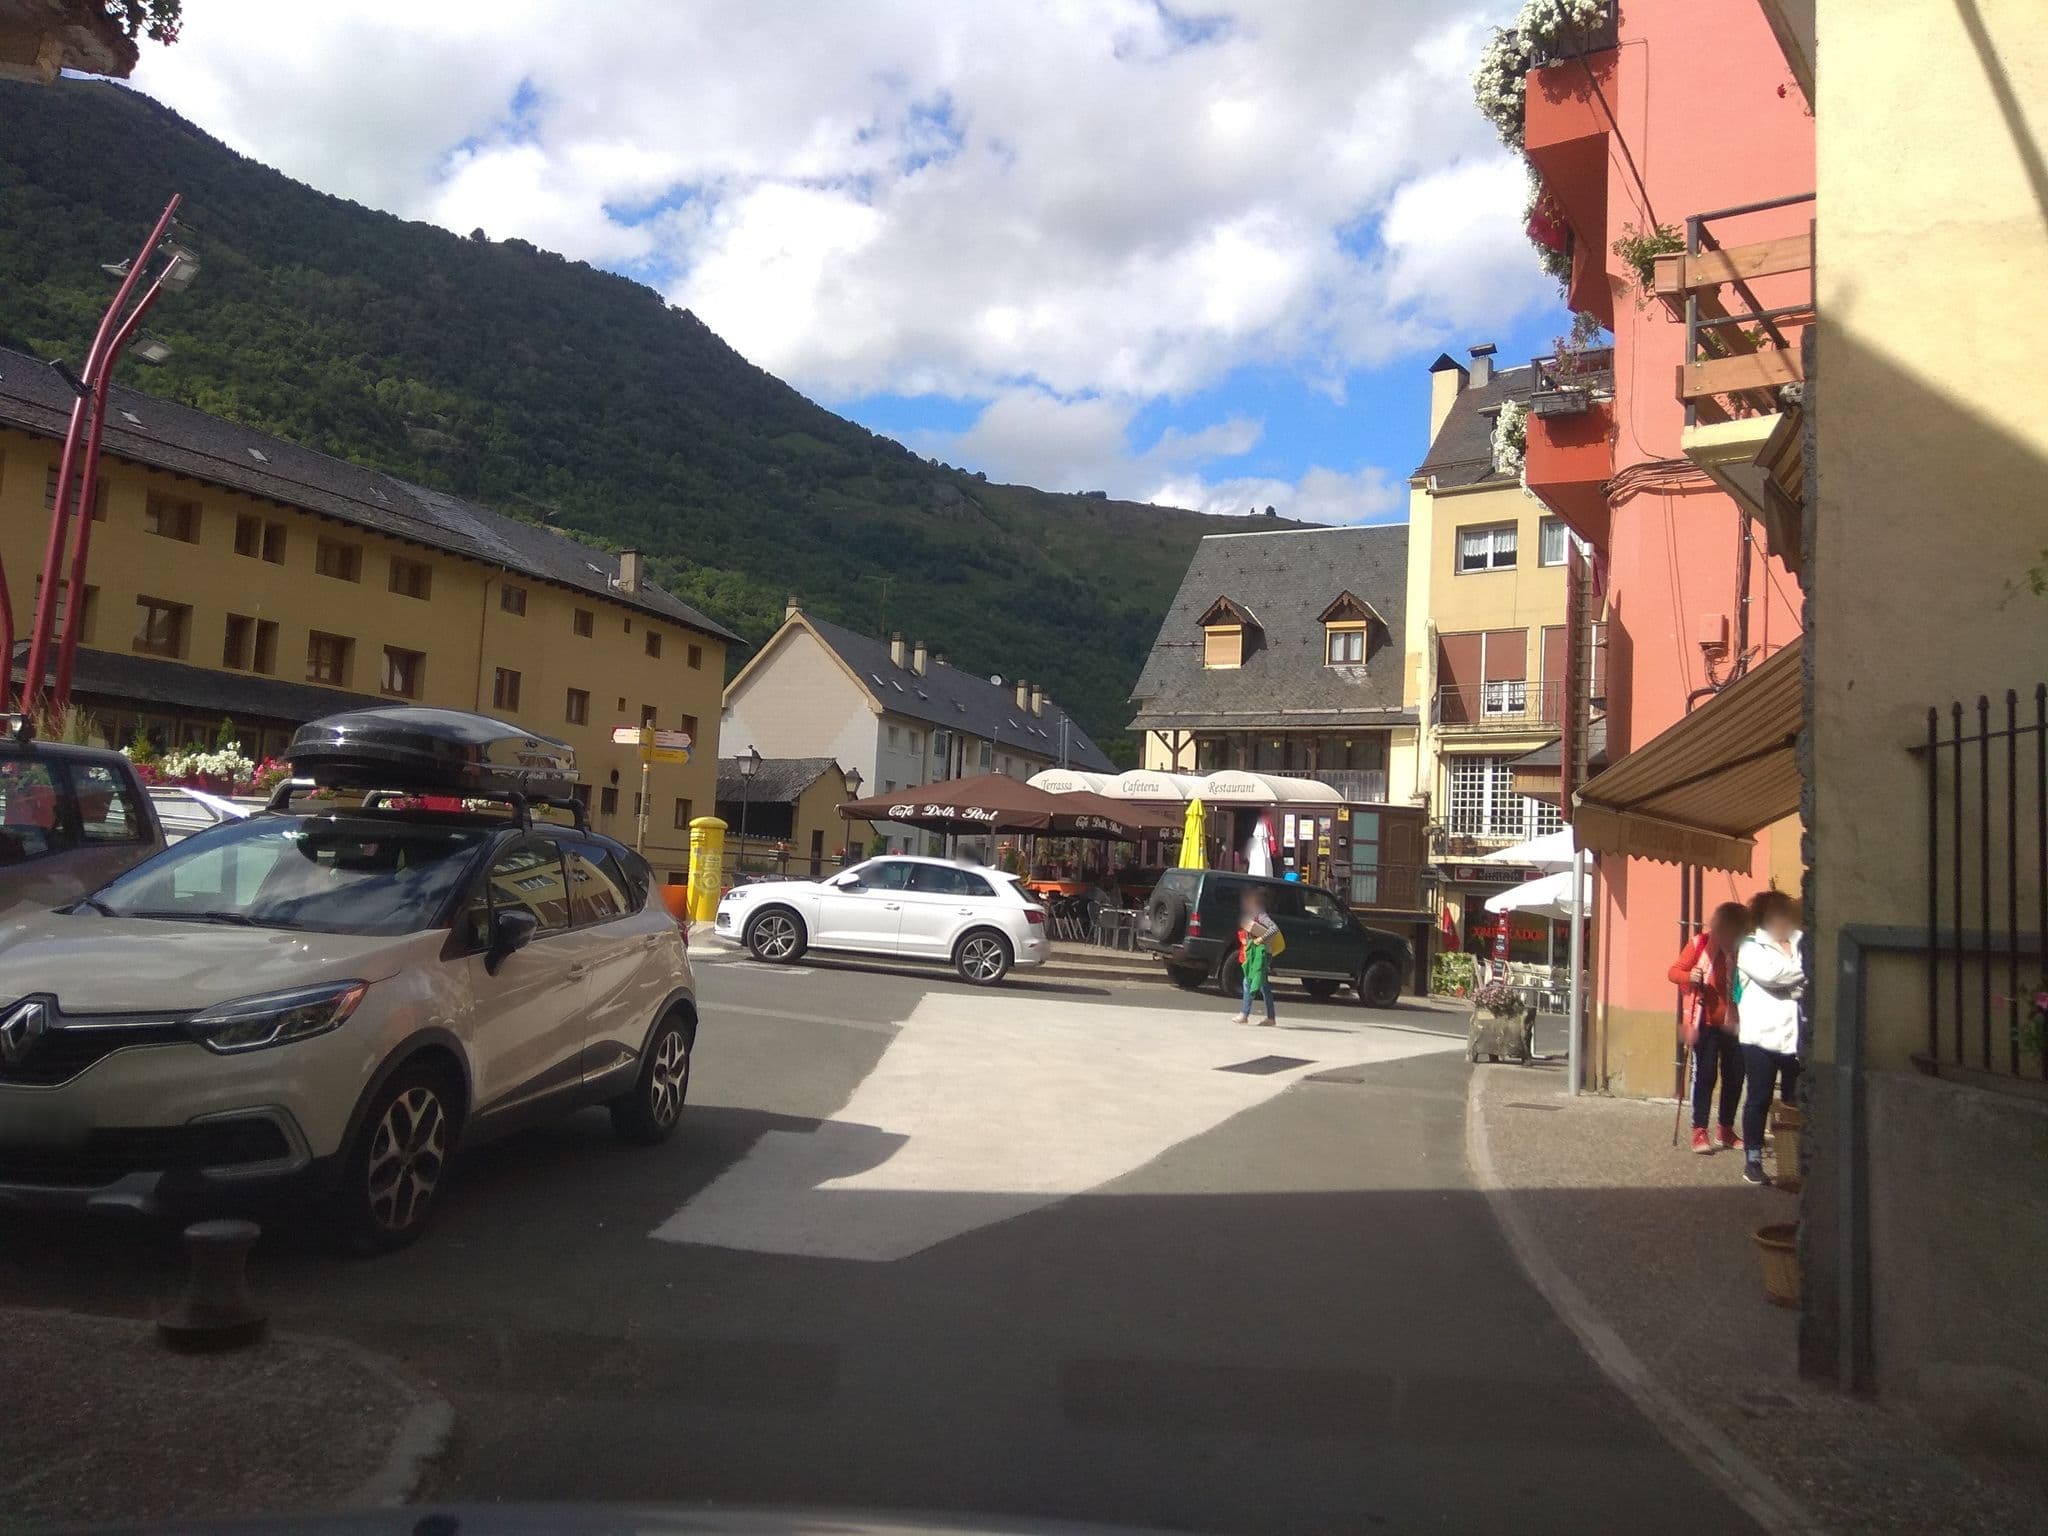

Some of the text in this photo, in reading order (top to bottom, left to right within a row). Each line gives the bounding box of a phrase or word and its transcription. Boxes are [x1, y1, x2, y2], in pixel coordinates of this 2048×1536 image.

[1040, 779, 1073, 791] Terrassa
[1122, 781, 1160, 793] Cafeteria
[1208, 781, 1256, 793] Restaurant
